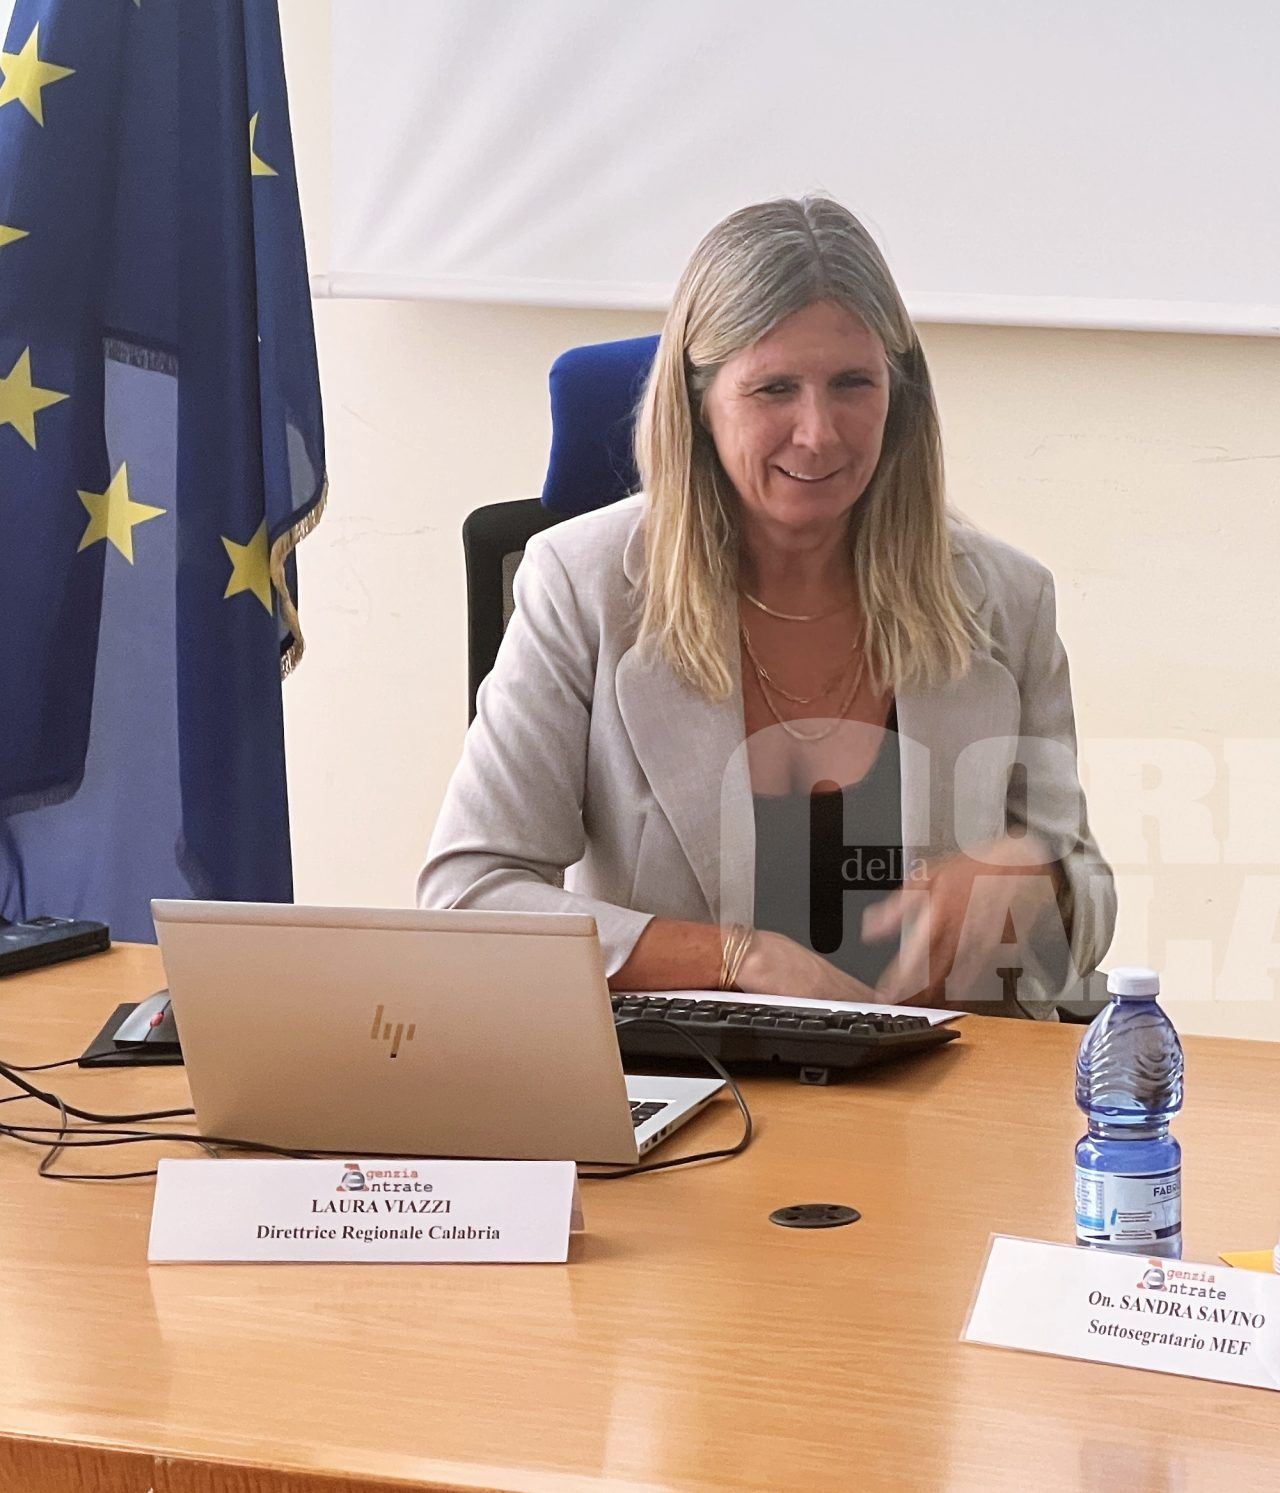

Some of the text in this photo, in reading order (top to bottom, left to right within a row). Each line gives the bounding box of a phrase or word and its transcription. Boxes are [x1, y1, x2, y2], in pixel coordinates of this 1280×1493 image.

[371, 1005, 416, 1058] hp
[311, 1199, 451, 1214] LAURA VIAZZI
[256, 1225, 501, 1243] Direttrice Regionale Calabria
[1088, 1291, 1266, 1329] On. SANDRA SAVINO
[1088, 1319, 1252, 1356] Sottosegratario MEF
